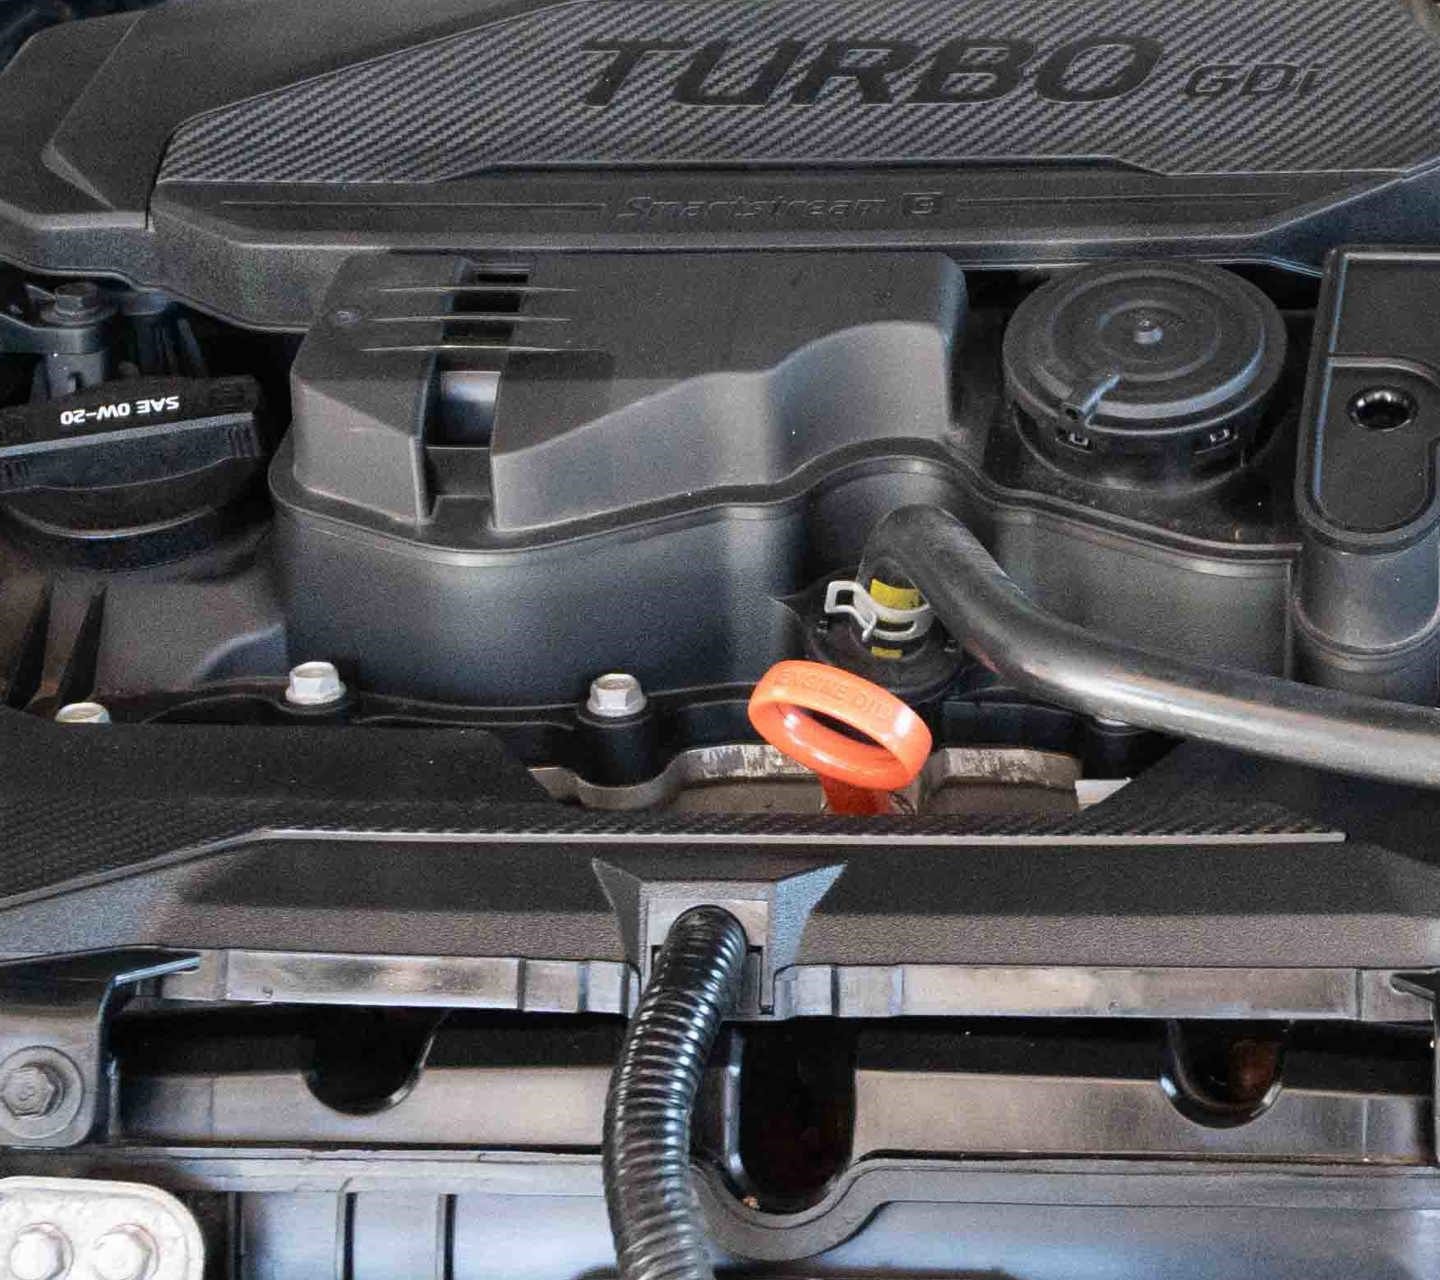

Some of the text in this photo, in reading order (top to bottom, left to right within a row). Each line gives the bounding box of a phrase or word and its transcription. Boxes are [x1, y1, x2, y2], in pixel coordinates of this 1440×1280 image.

[581, 36, 1322, 108] TURBO GDi
[616, 195, 886, 220] Smartstream
[61, 396, 180, 425] SAE 0W-20
